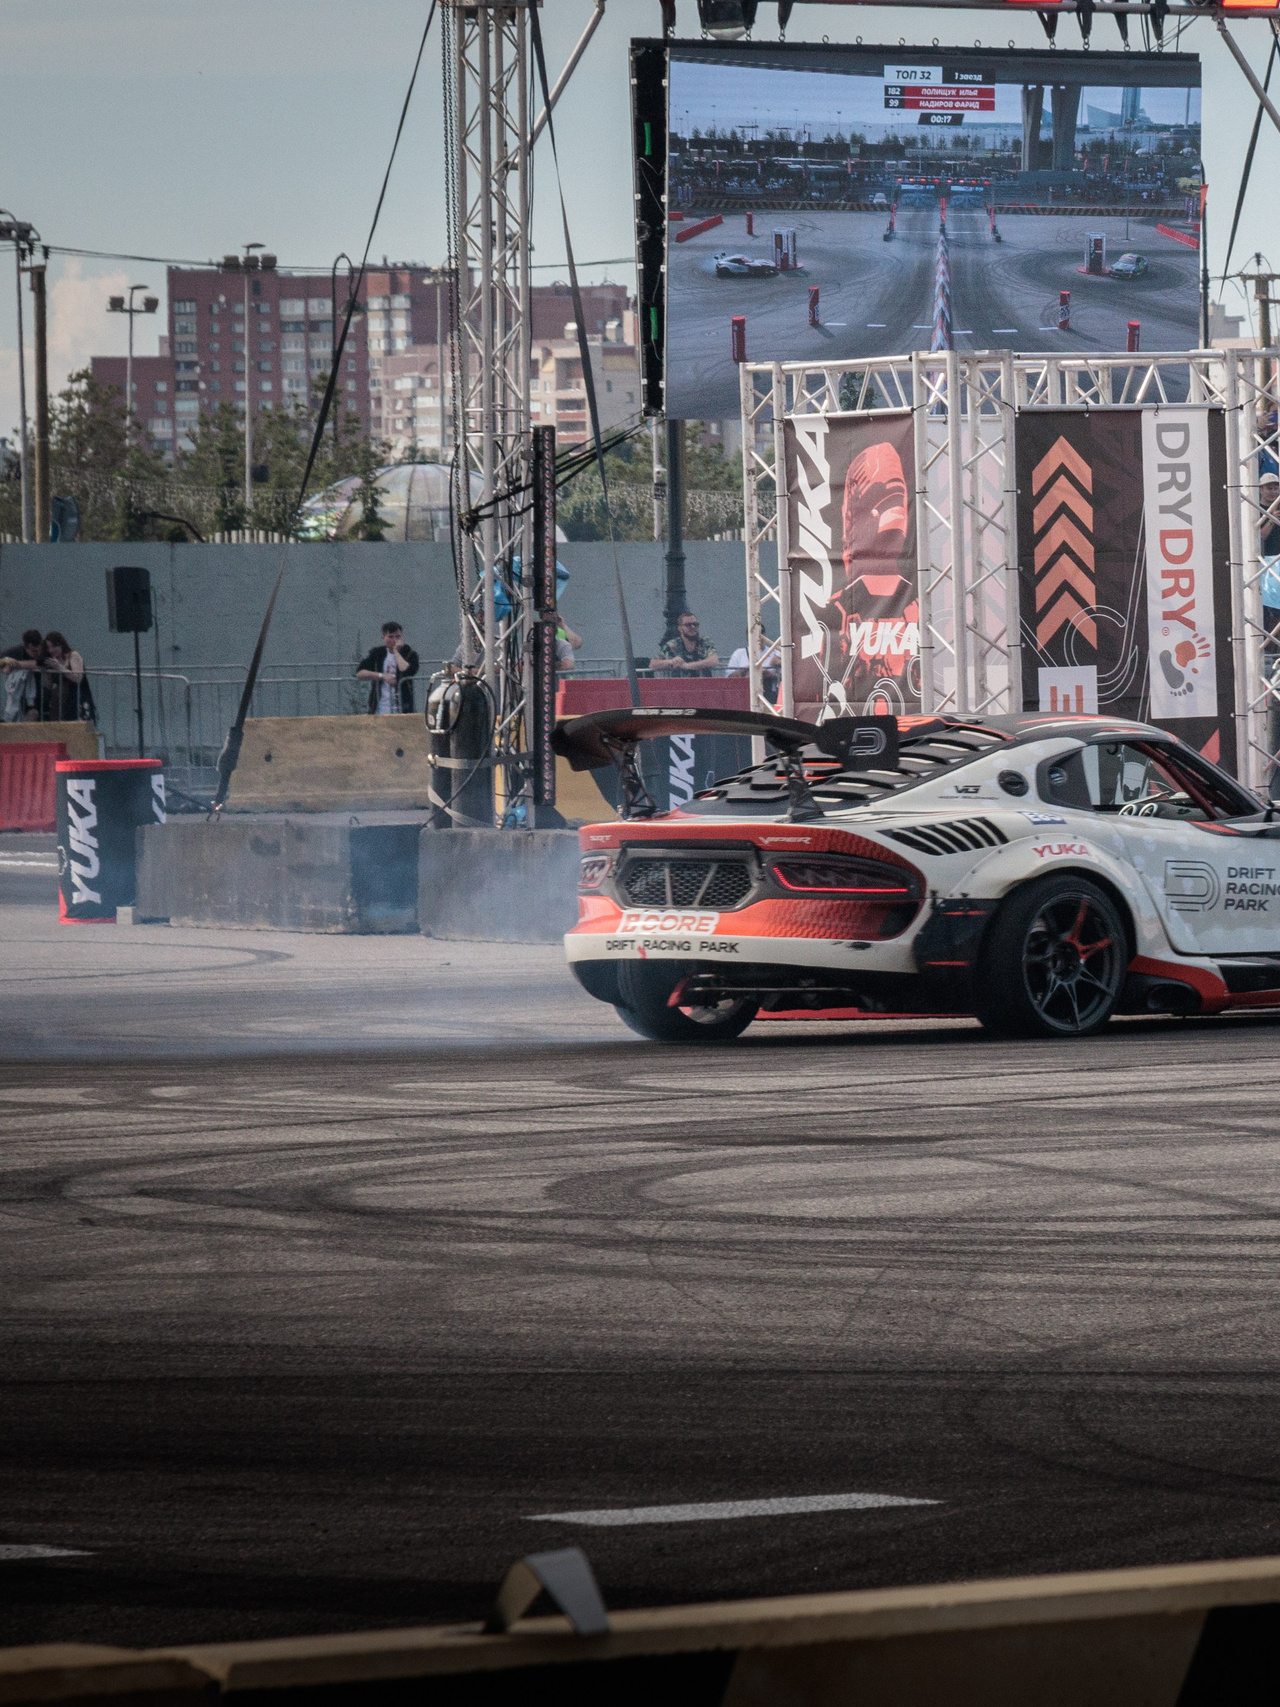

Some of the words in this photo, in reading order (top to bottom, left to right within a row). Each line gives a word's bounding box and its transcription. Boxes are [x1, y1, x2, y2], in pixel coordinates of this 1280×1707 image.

[896, 70, 917, 80] ТОП
[919, 71, 931, 80] 32
[887, 87, 901, 95] 182
[921, 88, 956, 97] ПОЛИЩУК
[889, 99, 899, 107] 99
[919, 100, 953, 108] НАДИРОВ
[954, 101, 980, 109] ФАРИД
[930, 115, 952, 123] 00:17
[1156, 422, 1196, 632] DRYDRY
[793, 416, 832, 659] YUKA
[849, 622, 920, 656] YUKA
[67, 779, 101, 904] YUKA
[589, 834, 612, 843] SRT
[759, 836, 812, 844] VIPER
[1032, 843, 1091, 858] YUKA
[1227, 867, 1276, 880] DRIFT
[1224, 898, 1269, 912] PARK
[606, 939, 636, 951] DRIFT
[643, 939, 691, 952] RACING
[699, 940, 739, 954] PARK
